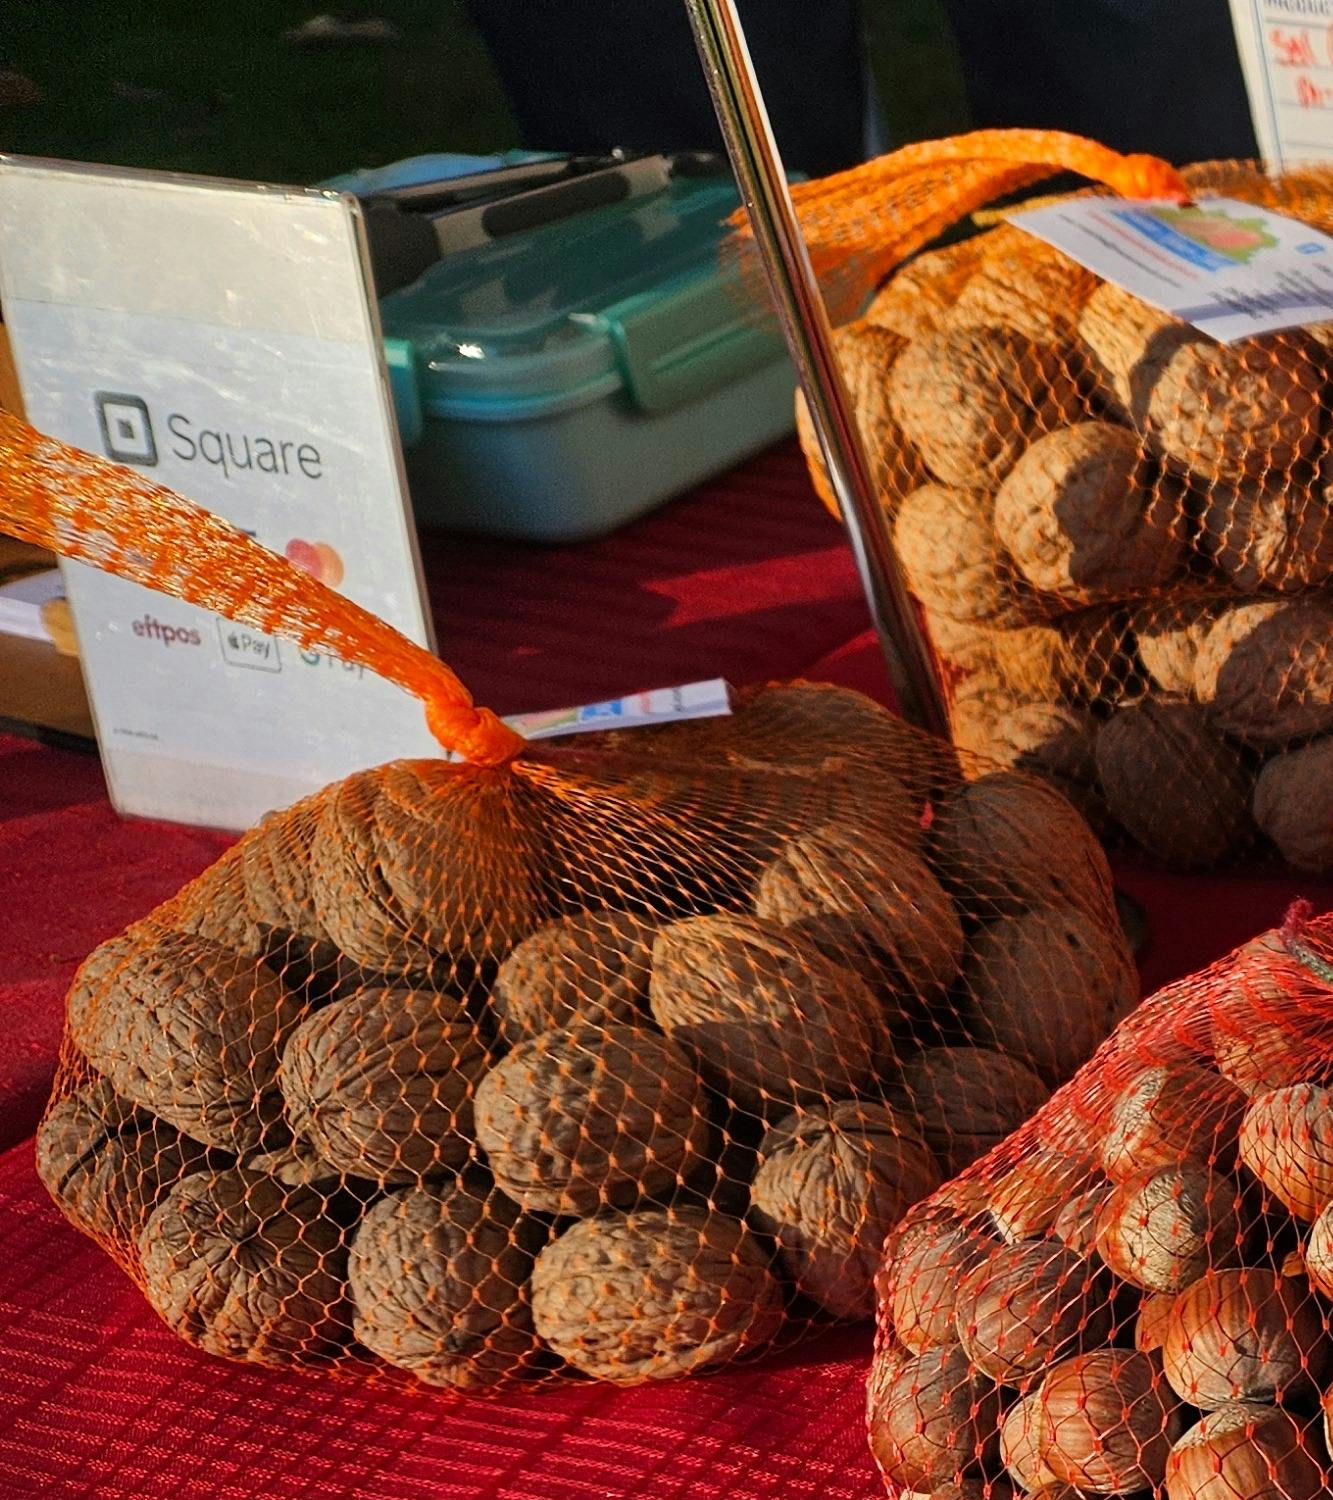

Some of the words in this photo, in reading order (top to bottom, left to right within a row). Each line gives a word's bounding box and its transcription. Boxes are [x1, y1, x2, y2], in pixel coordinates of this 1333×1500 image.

[167, 413, 322, 479] Square
[132, 614, 201, 647] eftpos
[241, 633, 271, 659] Pay
